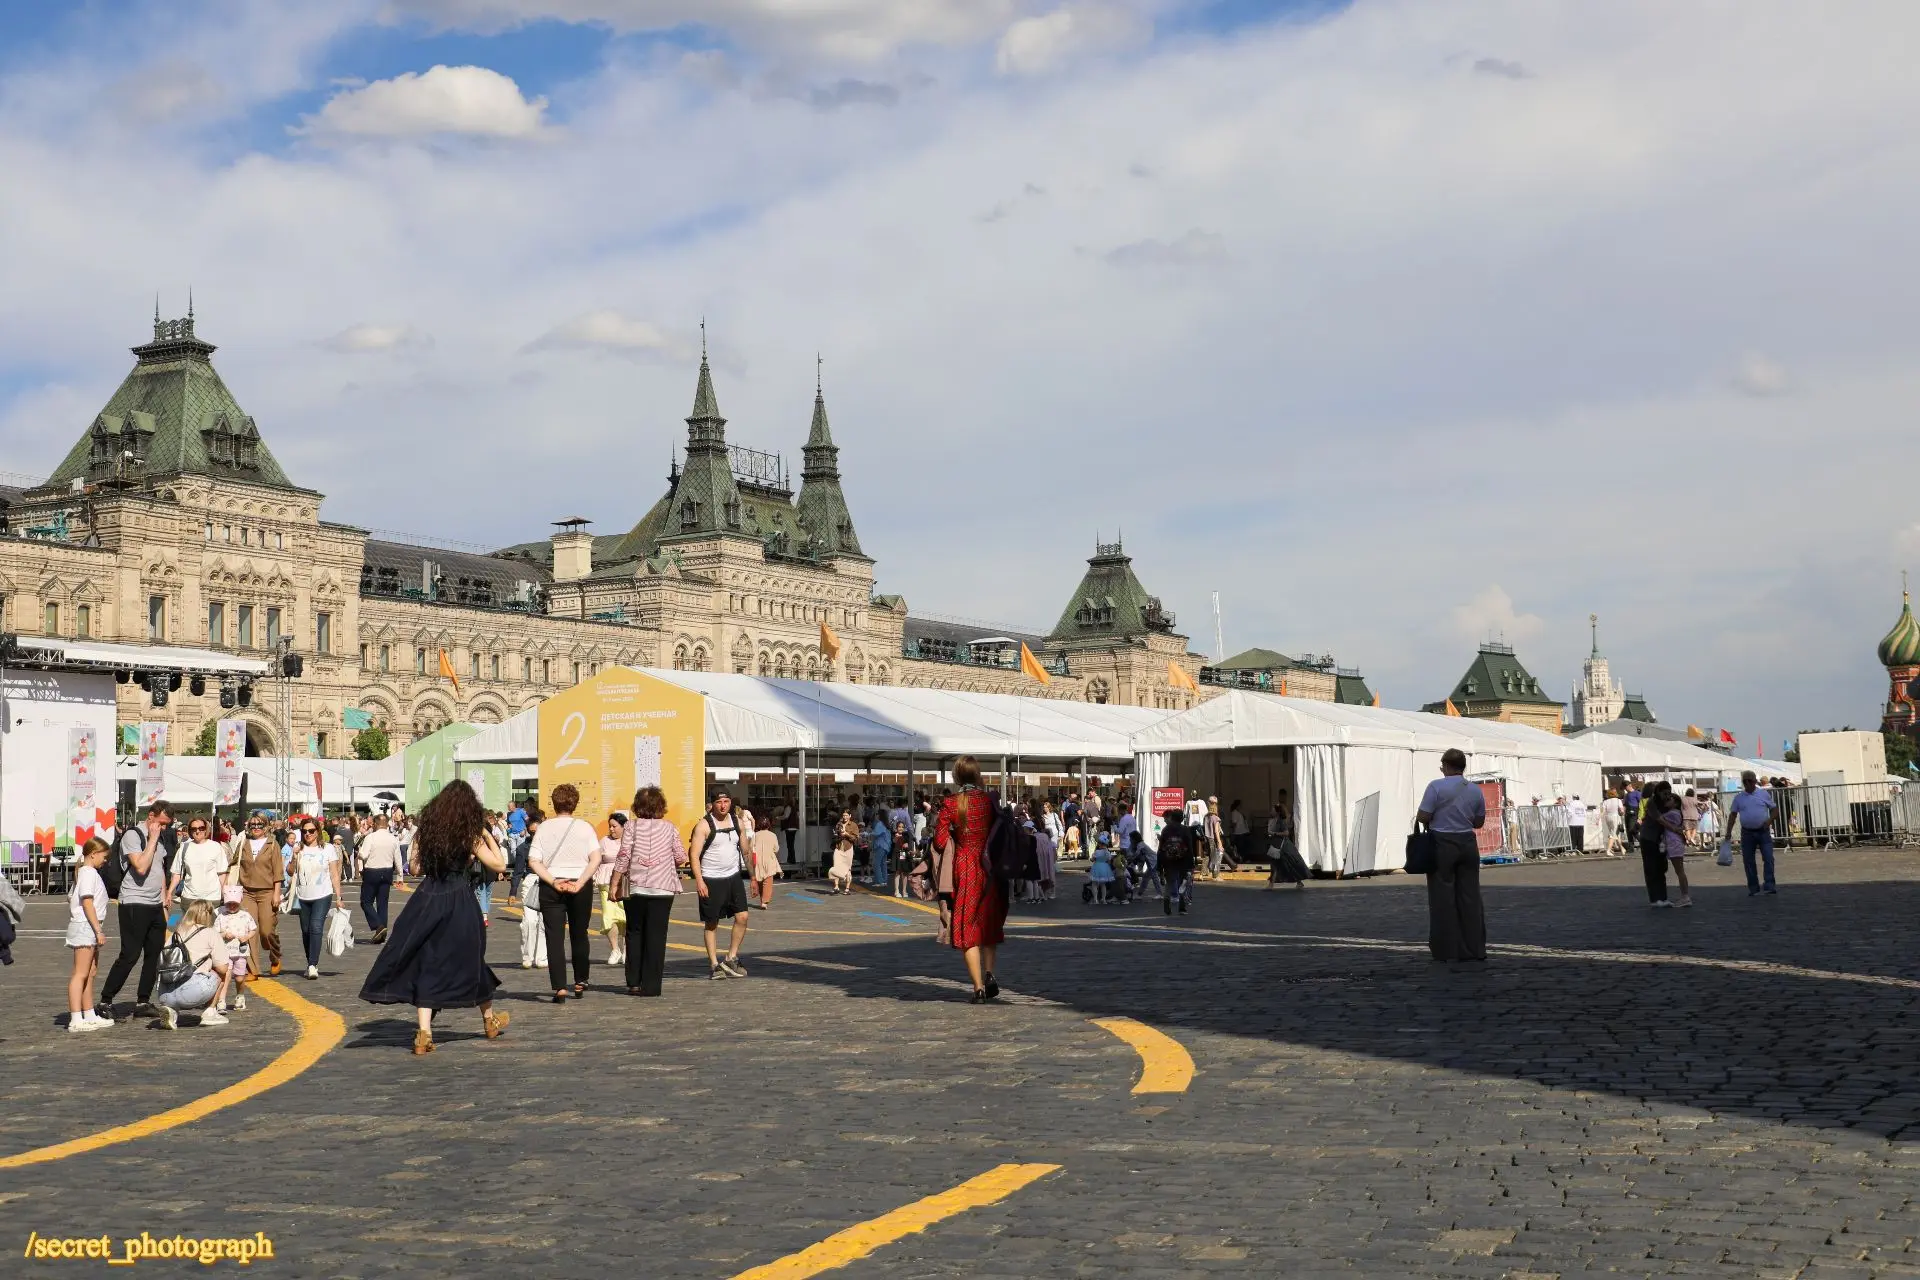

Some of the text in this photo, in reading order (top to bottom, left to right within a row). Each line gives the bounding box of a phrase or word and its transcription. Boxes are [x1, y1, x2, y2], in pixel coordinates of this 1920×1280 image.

[601, 712, 635, 721] ДЕТСКАЯ
[600, 721, 649, 731] ЛИТЕРАТУРА
[555, 712, 589, 769] 2
